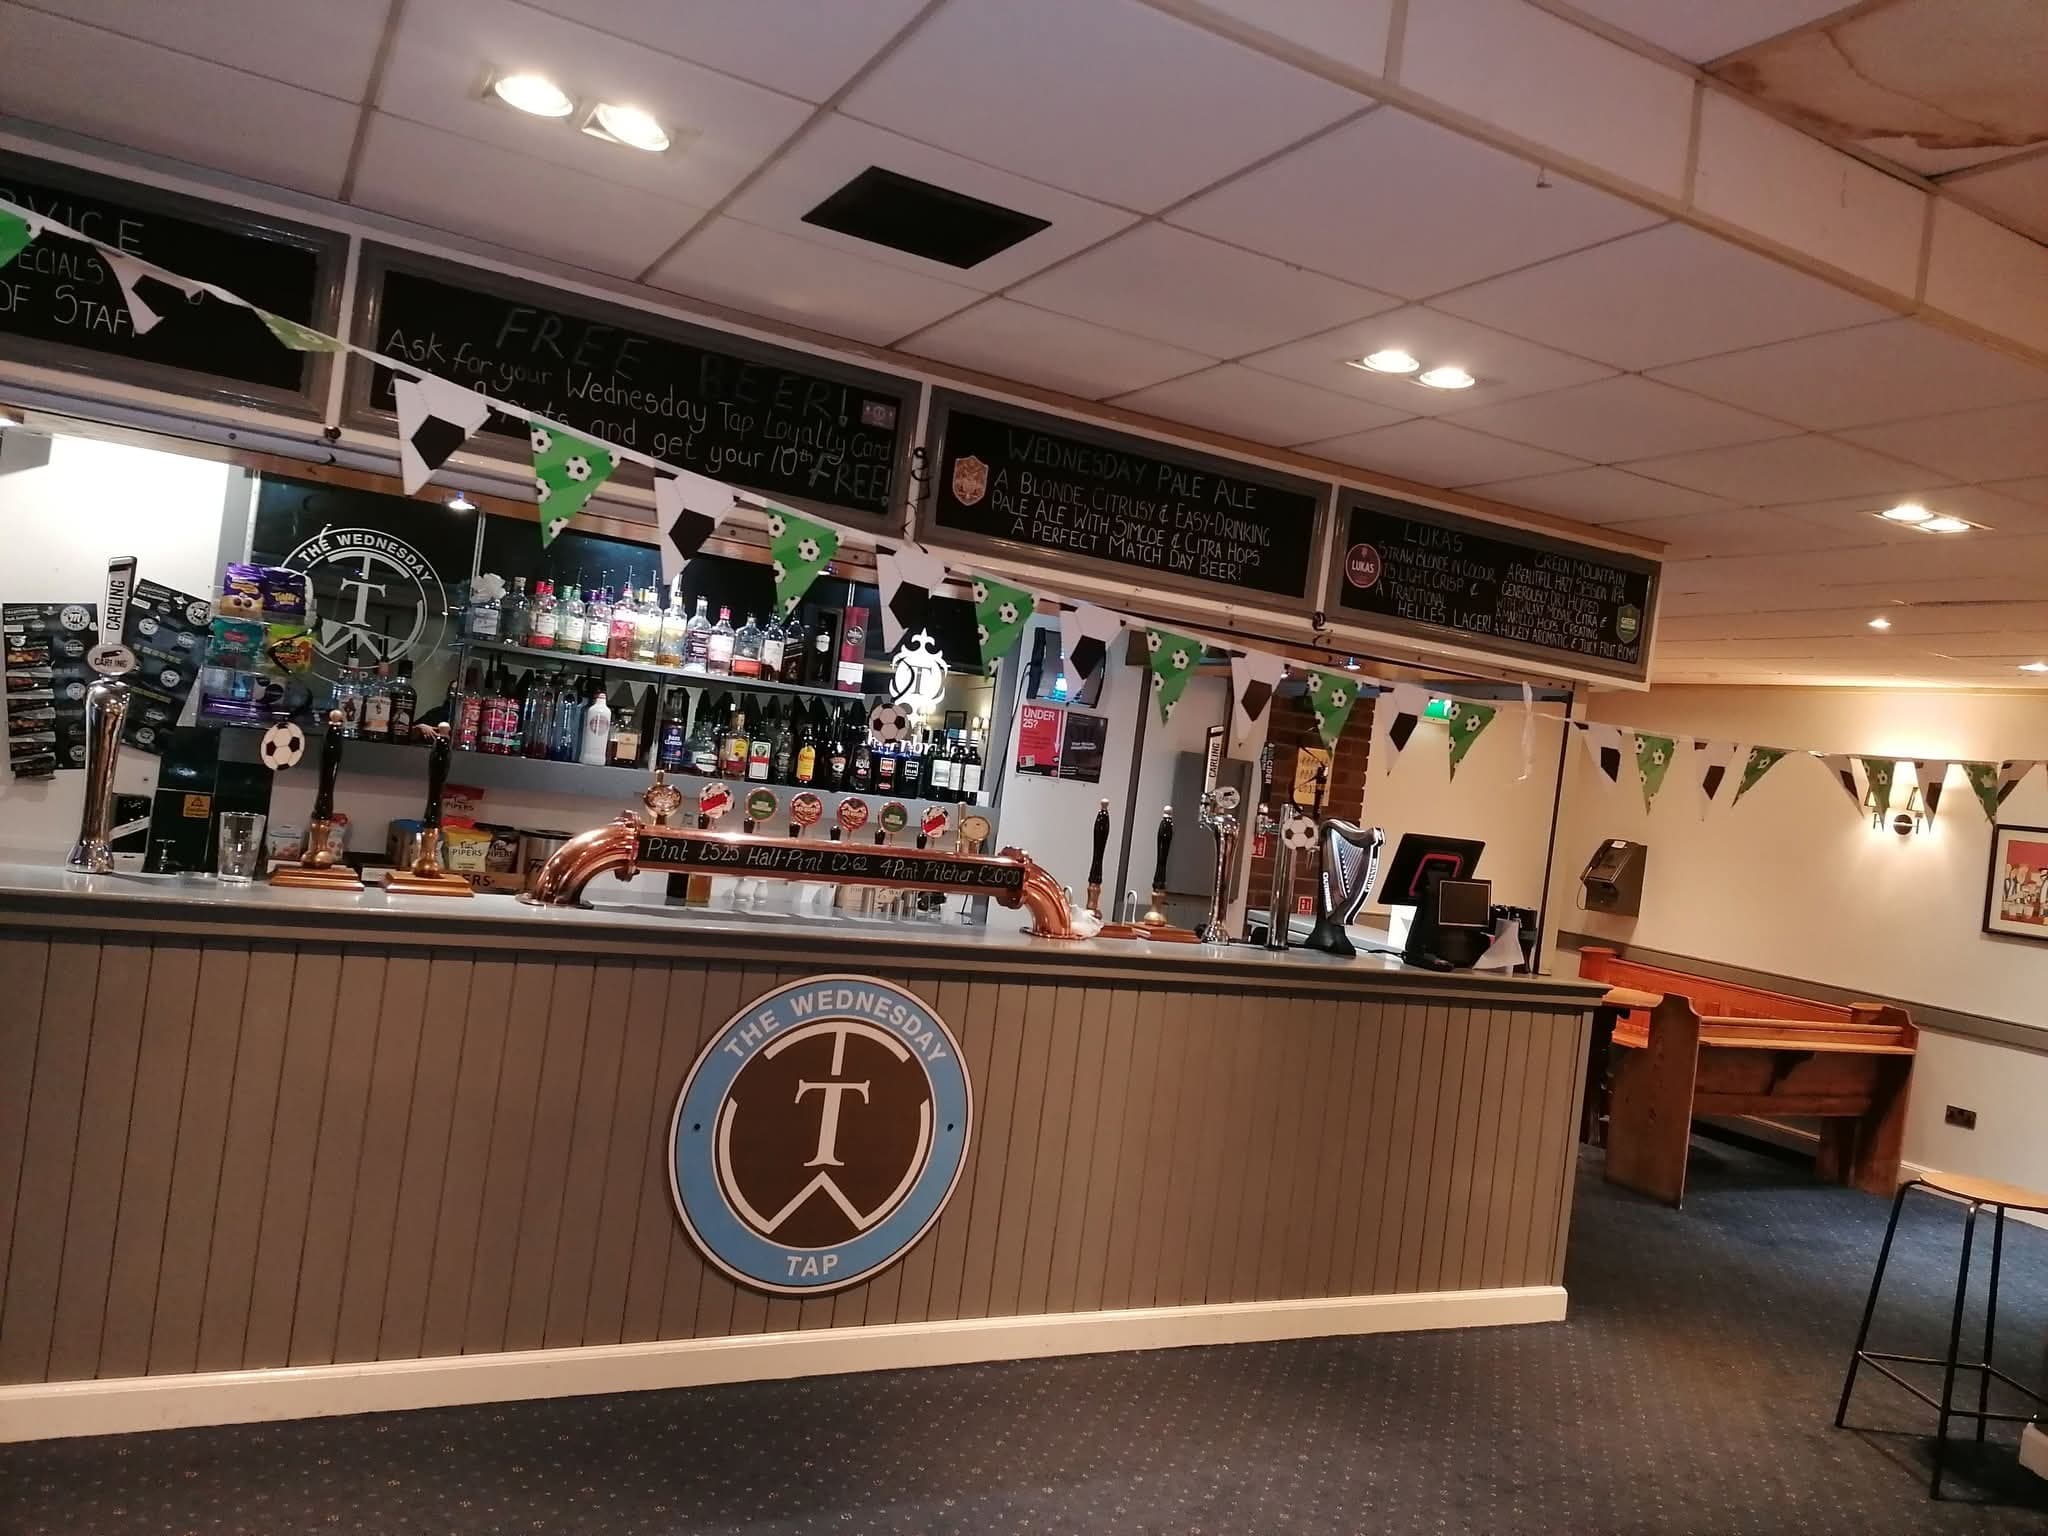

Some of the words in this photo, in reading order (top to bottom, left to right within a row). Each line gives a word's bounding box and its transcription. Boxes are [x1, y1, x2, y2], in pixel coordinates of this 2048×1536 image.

[54, 284, 136, 338] STAF
[497, 307, 649, 381] FREE
[701, 353, 849, 428] BEER!
[384, 328, 447, 363] Ask
[452, 342, 495, 374] for
[492, 360, 553, 393] your
[566, 367, 708, 434] Wednesday
[717, 400, 755, 441] Tap
[763, 408, 847, 466] Loyalty
[851, 432, 893, 462] Card
[590, 417, 636, 446] and
[650, 432, 697, 460] get
[704, 445, 765, 474] your
[769, 444, 814, 477] 10th
[808, 451, 892, 508] FREE!
[1007, 428, 1147, 484] WEDNESDAY
[1157, 464, 1204, 499] PALE
[1213, 479, 1257, 511] ALE
[993, 467, 1009, 490] A
[1092, 487, 1157, 521] CITRUSY
[1159, 503, 1169, 525] &
[1175, 502, 1273, 548] EASY-DRINKING
[991, 491, 1029, 517] PALE
[1035, 499, 1067, 525] ALE
[1073, 505, 1110, 535] WITH
[1112, 515, 1165, 547] SIMCOE
[1171, 532, 1182, 549] &
[1184, 532, 1222, 558] CITRA
[1227, 543, 1260, 567] HOPS
[1404, 521, 1464, 553] LUKAS
[298, 537, 332, 563] THE
[336, 533, 433, 582] WEDNESDAY
[1011, 516, 1025, 536] A
[1032, 521, 1100, 552] PERFECT
[1108, 534, 1161, 565] MATCH
[1168, 549, 1194, 571] DAY
[1199, 555, 1242, 581] BEER!
[1351, 559, 1375, 574] LUKAS
[1432, 570, 1464, 593] CRISP
[1574, 559, 1627, 585] MOUNTAIN
[106, 579, 126, 631] CARLING
[1375, 579, 1384, 598] A
[1389, 580, 1448, 609] TRADITIONAL
[1398, 599, 1446, 625] HELLES
[1453, 607, 1492, 634] LAGER!
[94, 655, 129, 669] CARLING
[1022, 719, 1038, 729] 25?
[1023, 707, 1055, 721] UNDER
[1208, 743, 1220, 778] CARLING
[1264, 760, 1273, 785] CIDER
[452, 848, 482, 857] PIPERS
[647, 837, 689, 860] Pint
[724, 1009, 780, 1059] THE
[789, 989, 947, 1064] WEDNESDAY
[786, 1254, 839, 1277] TAP
